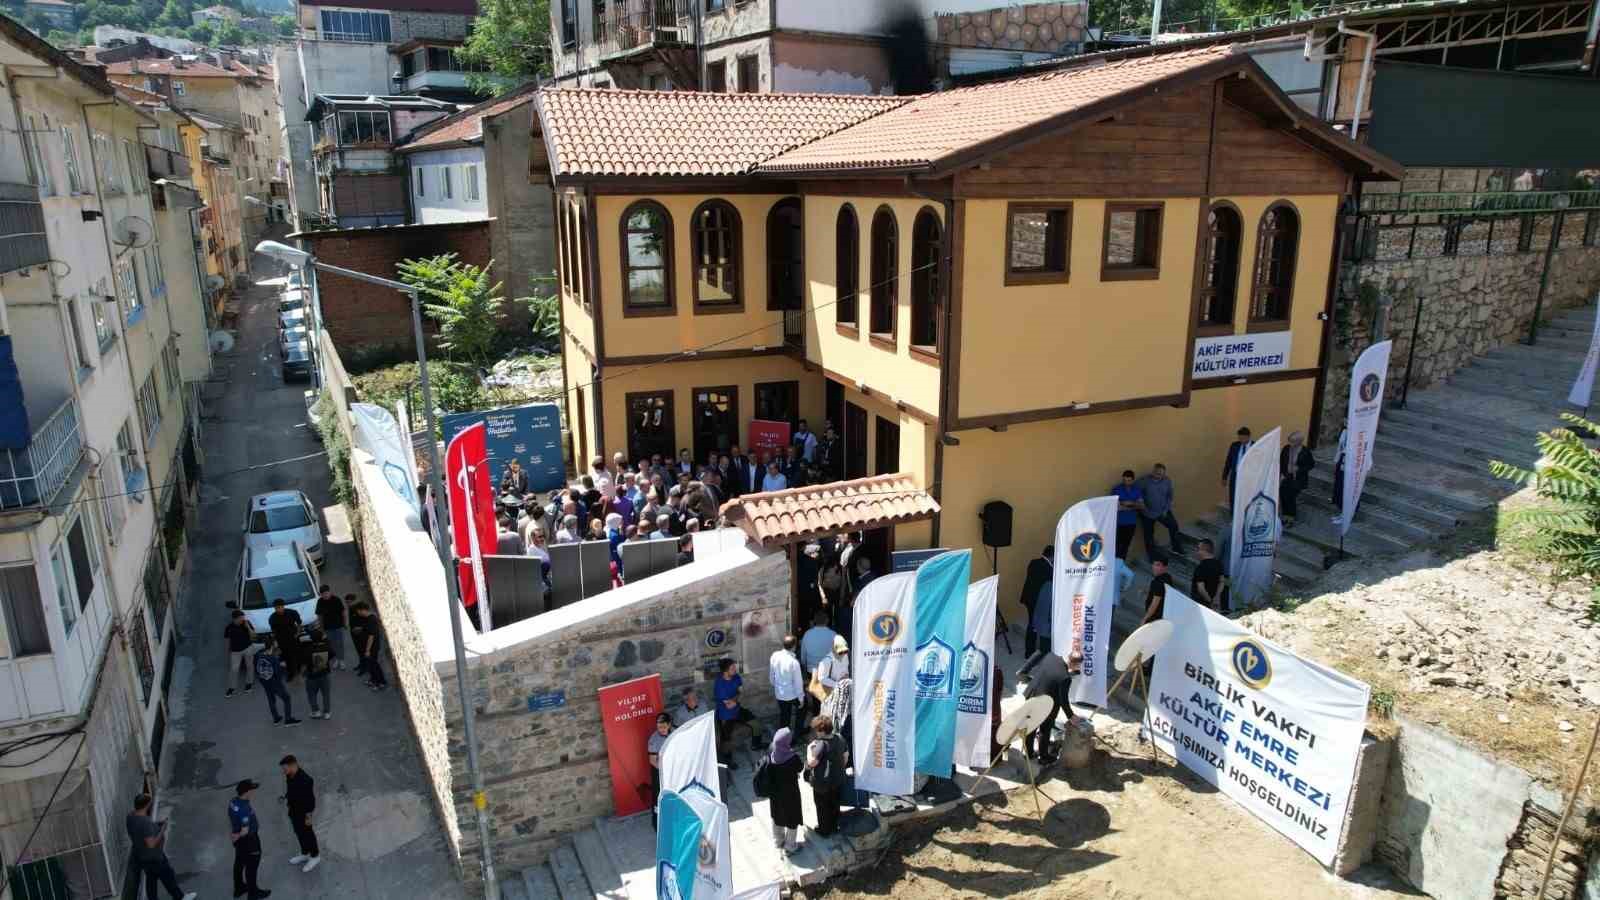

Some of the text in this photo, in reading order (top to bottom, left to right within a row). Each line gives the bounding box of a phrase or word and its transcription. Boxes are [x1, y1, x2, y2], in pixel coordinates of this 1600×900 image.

[1194, 354, 1284, 373] KÜLTÜR MERKEZİ
[1197, 342, 1254, 357] AKİF EMRE
[614, 705, 654, 722] HOLDING
[616, 693, 647, 706] YILDIZ
[1184, 661, 1316, 749] BİRLİK VAKFI
[1159, 691, 1330, 811] KÜLTÜR MERKEZİ
[1190, 691, 1299, 766] AKİF EMRE
[1153, 715, 1329, 841] AÇILIŞIMIZA HOŞGELDİNİZ
